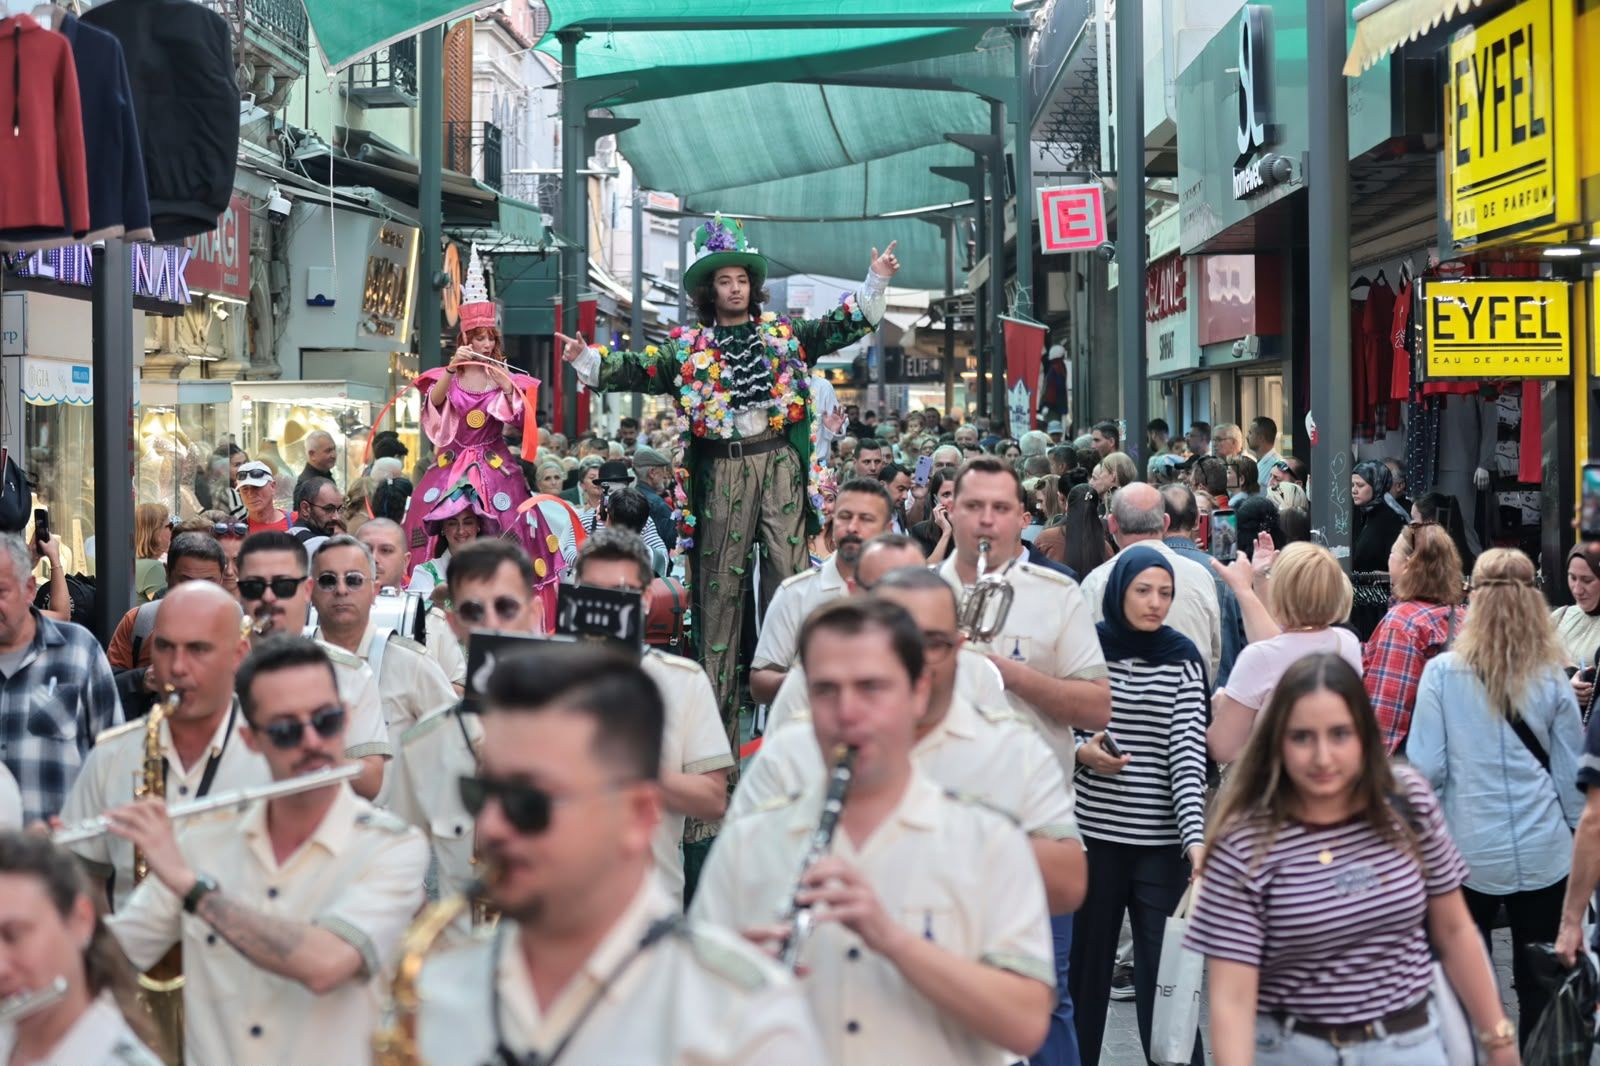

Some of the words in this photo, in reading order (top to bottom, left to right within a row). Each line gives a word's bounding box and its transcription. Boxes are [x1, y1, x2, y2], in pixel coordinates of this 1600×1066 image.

[1455, 23, 1546, 167] EYFEL
[1056, 199, 1091, 239] E
[1456, 206, 1477, 228] EAU
[1483, 198, 1496, 220] DE
[1503, 185, 1548, 212] PARFUM
[1145, 256, 1187, 323] CZANE
[1433, 296, 1562, 340] EYFEL
[1433, 356, 1461, 364] EAU
[1473, 356, 1491, 364] DE
